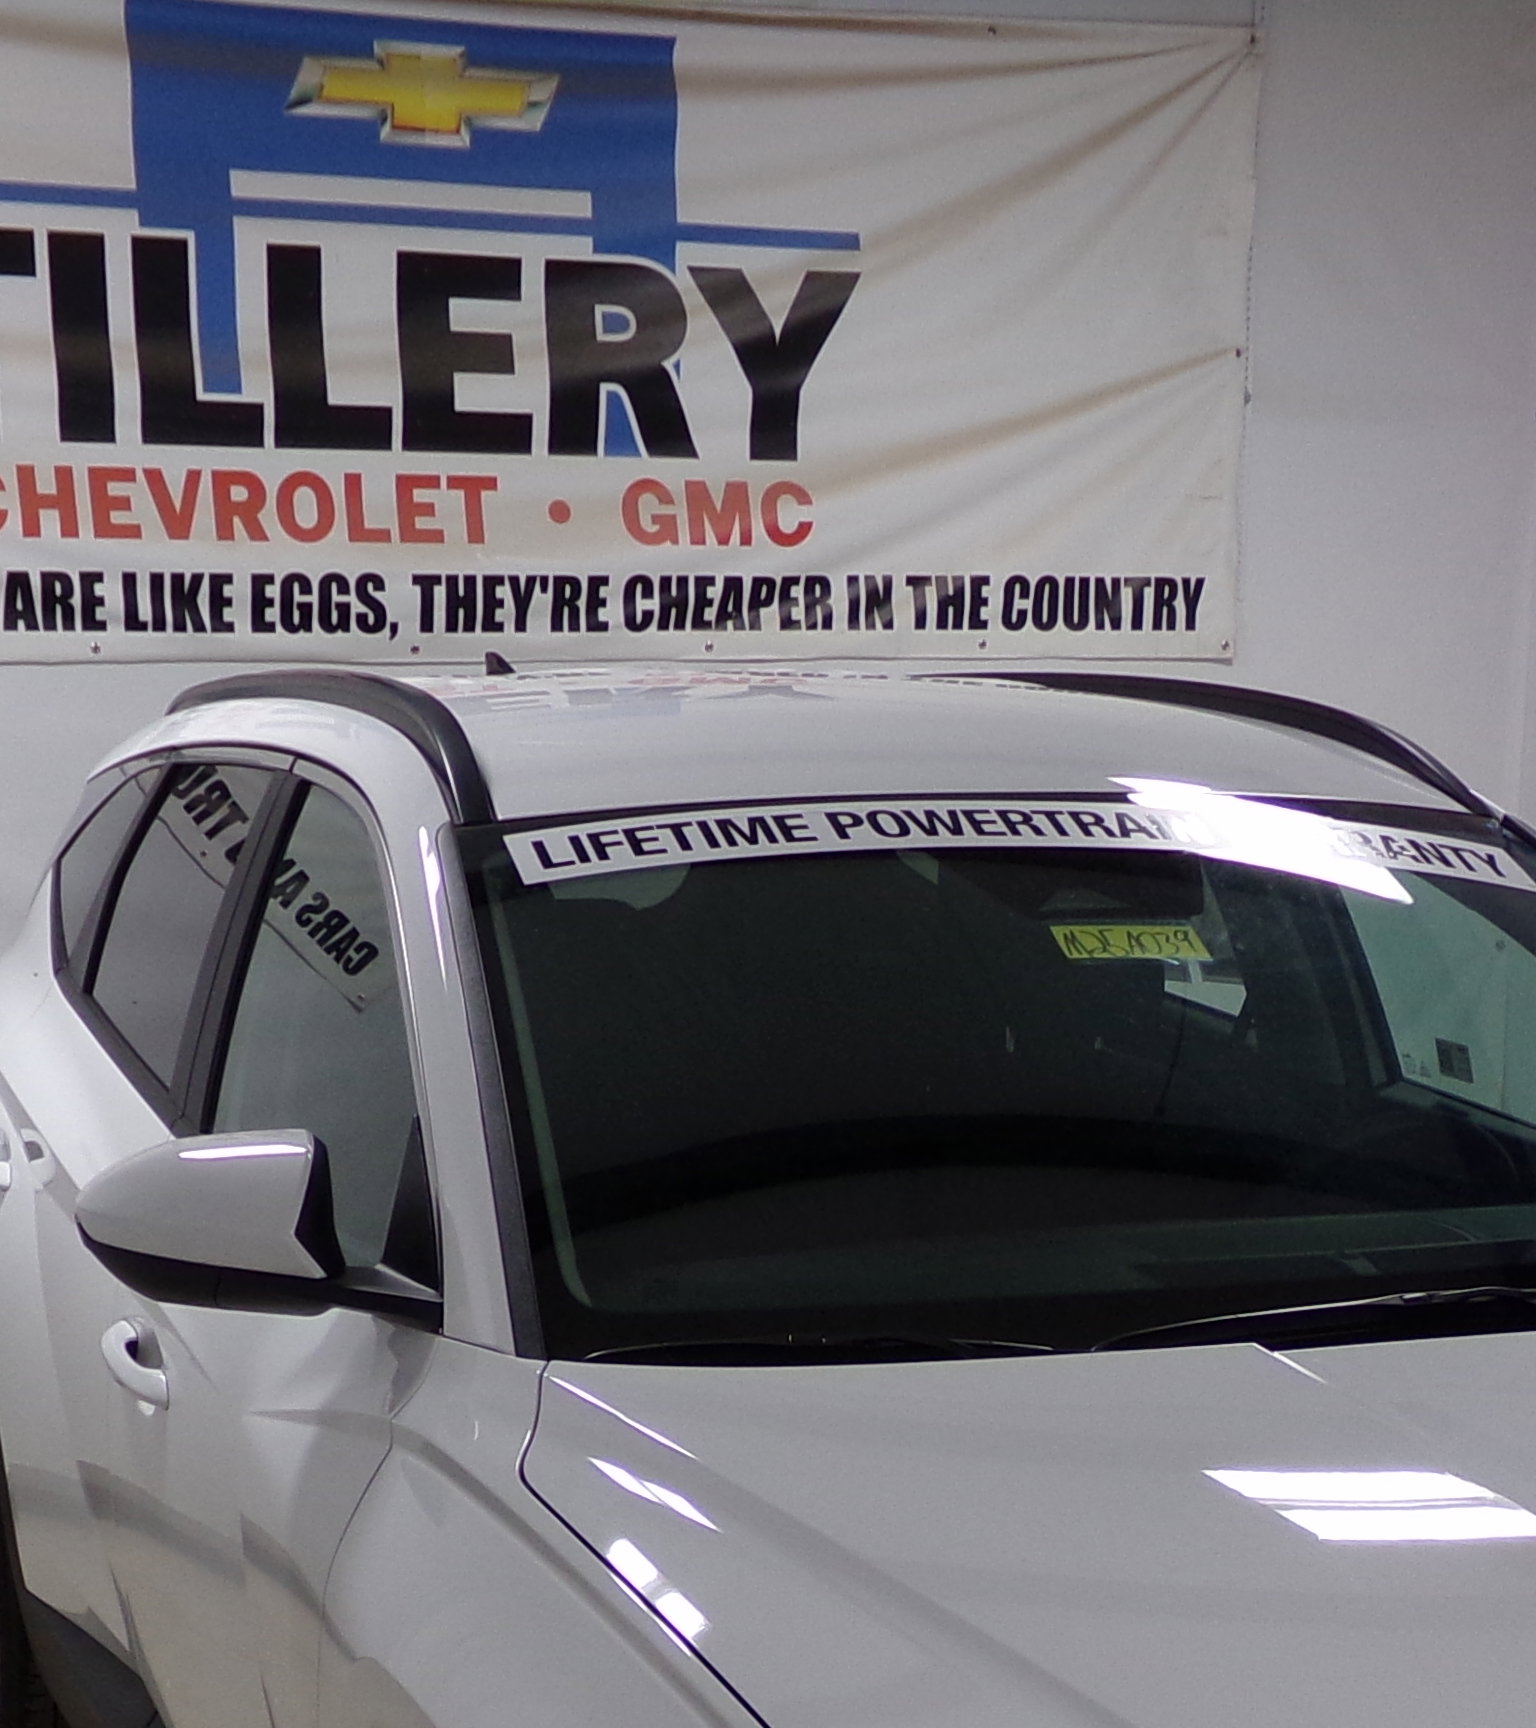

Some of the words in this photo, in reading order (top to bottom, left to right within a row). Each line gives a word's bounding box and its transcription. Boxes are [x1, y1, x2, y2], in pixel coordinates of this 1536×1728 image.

[620, 478, 814, 547] GMC
[2, 570, 108, 634] ARE
[123, 572, 234, 635] LIKE
[250, 573, 399, 641] EGGS,
[413, 572, 612, 635] THEY'RE
[622, 574, 833, 634] CHEAPER
[846, 574, 895, 633] IN
[906, 573, 990, 633] THE
[1001, 574, 1206, 634] COUNTRY
[531, 812, 818, 870] LIFETIME
